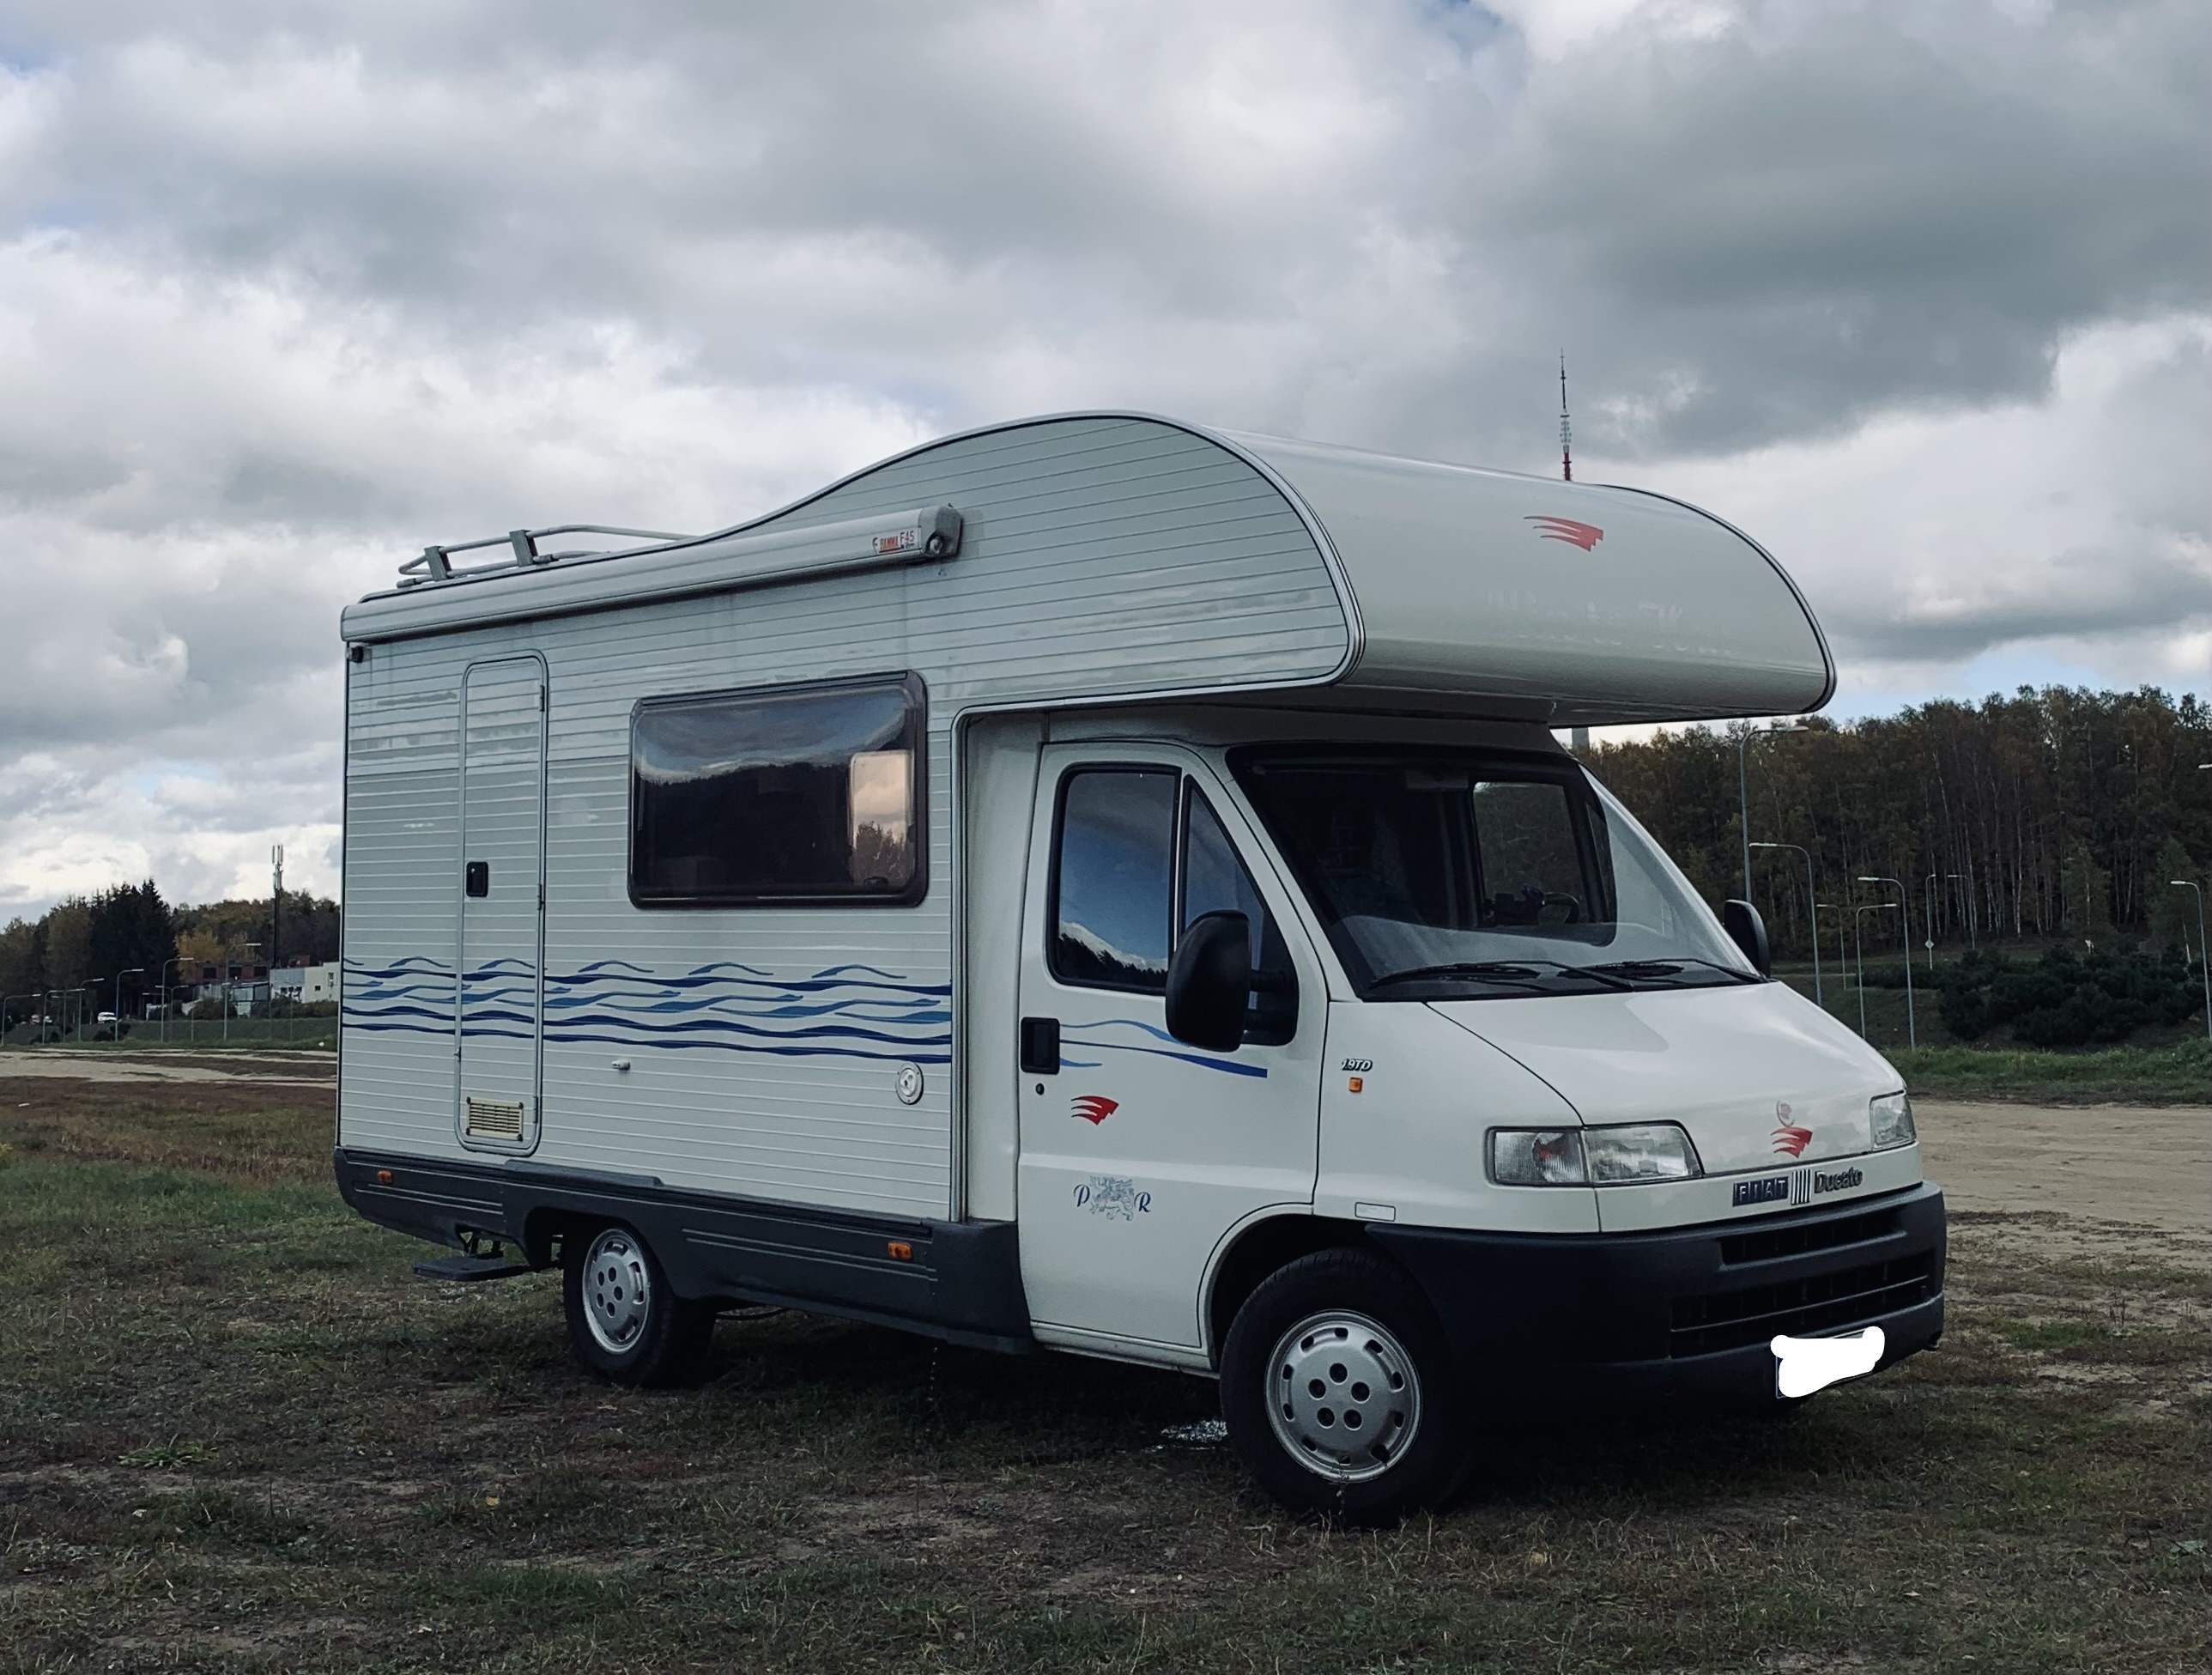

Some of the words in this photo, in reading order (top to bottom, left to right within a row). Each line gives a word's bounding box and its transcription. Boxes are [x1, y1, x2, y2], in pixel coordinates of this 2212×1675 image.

[900, 531, 914, 543] F45
[1737, 1179, 1786, 1202] FIAT
[1815, 1167, 1864, 1193] Ducato
[1134, 1191, 1151, 1212] R
